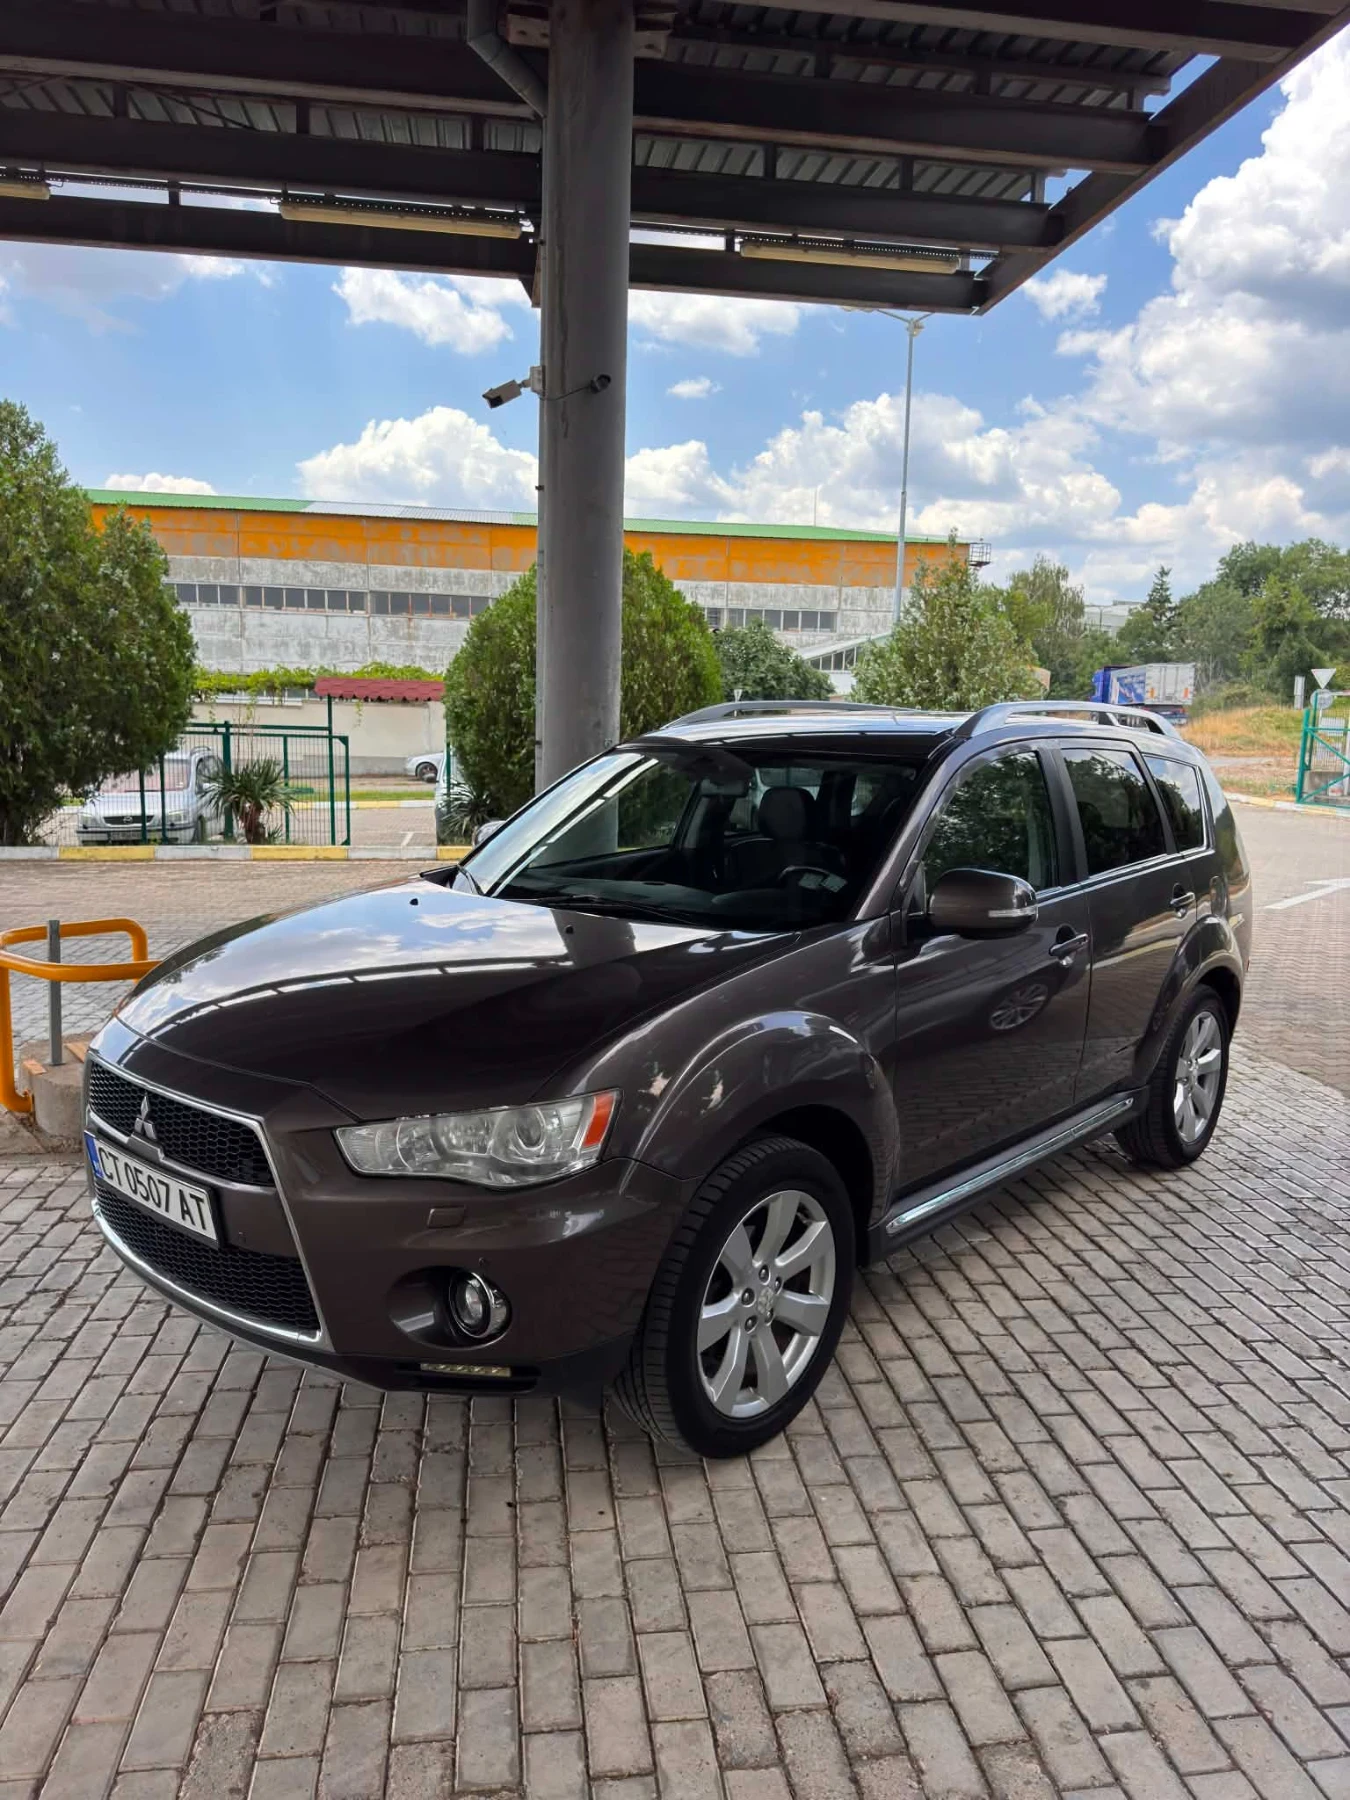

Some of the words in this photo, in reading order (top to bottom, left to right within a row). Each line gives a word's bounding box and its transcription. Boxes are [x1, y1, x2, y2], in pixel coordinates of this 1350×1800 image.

[98, 1147, 122, 1186] CT
[125, 1161, 170, 1212] 0507
[179, 1189, 206, 1230] AT
